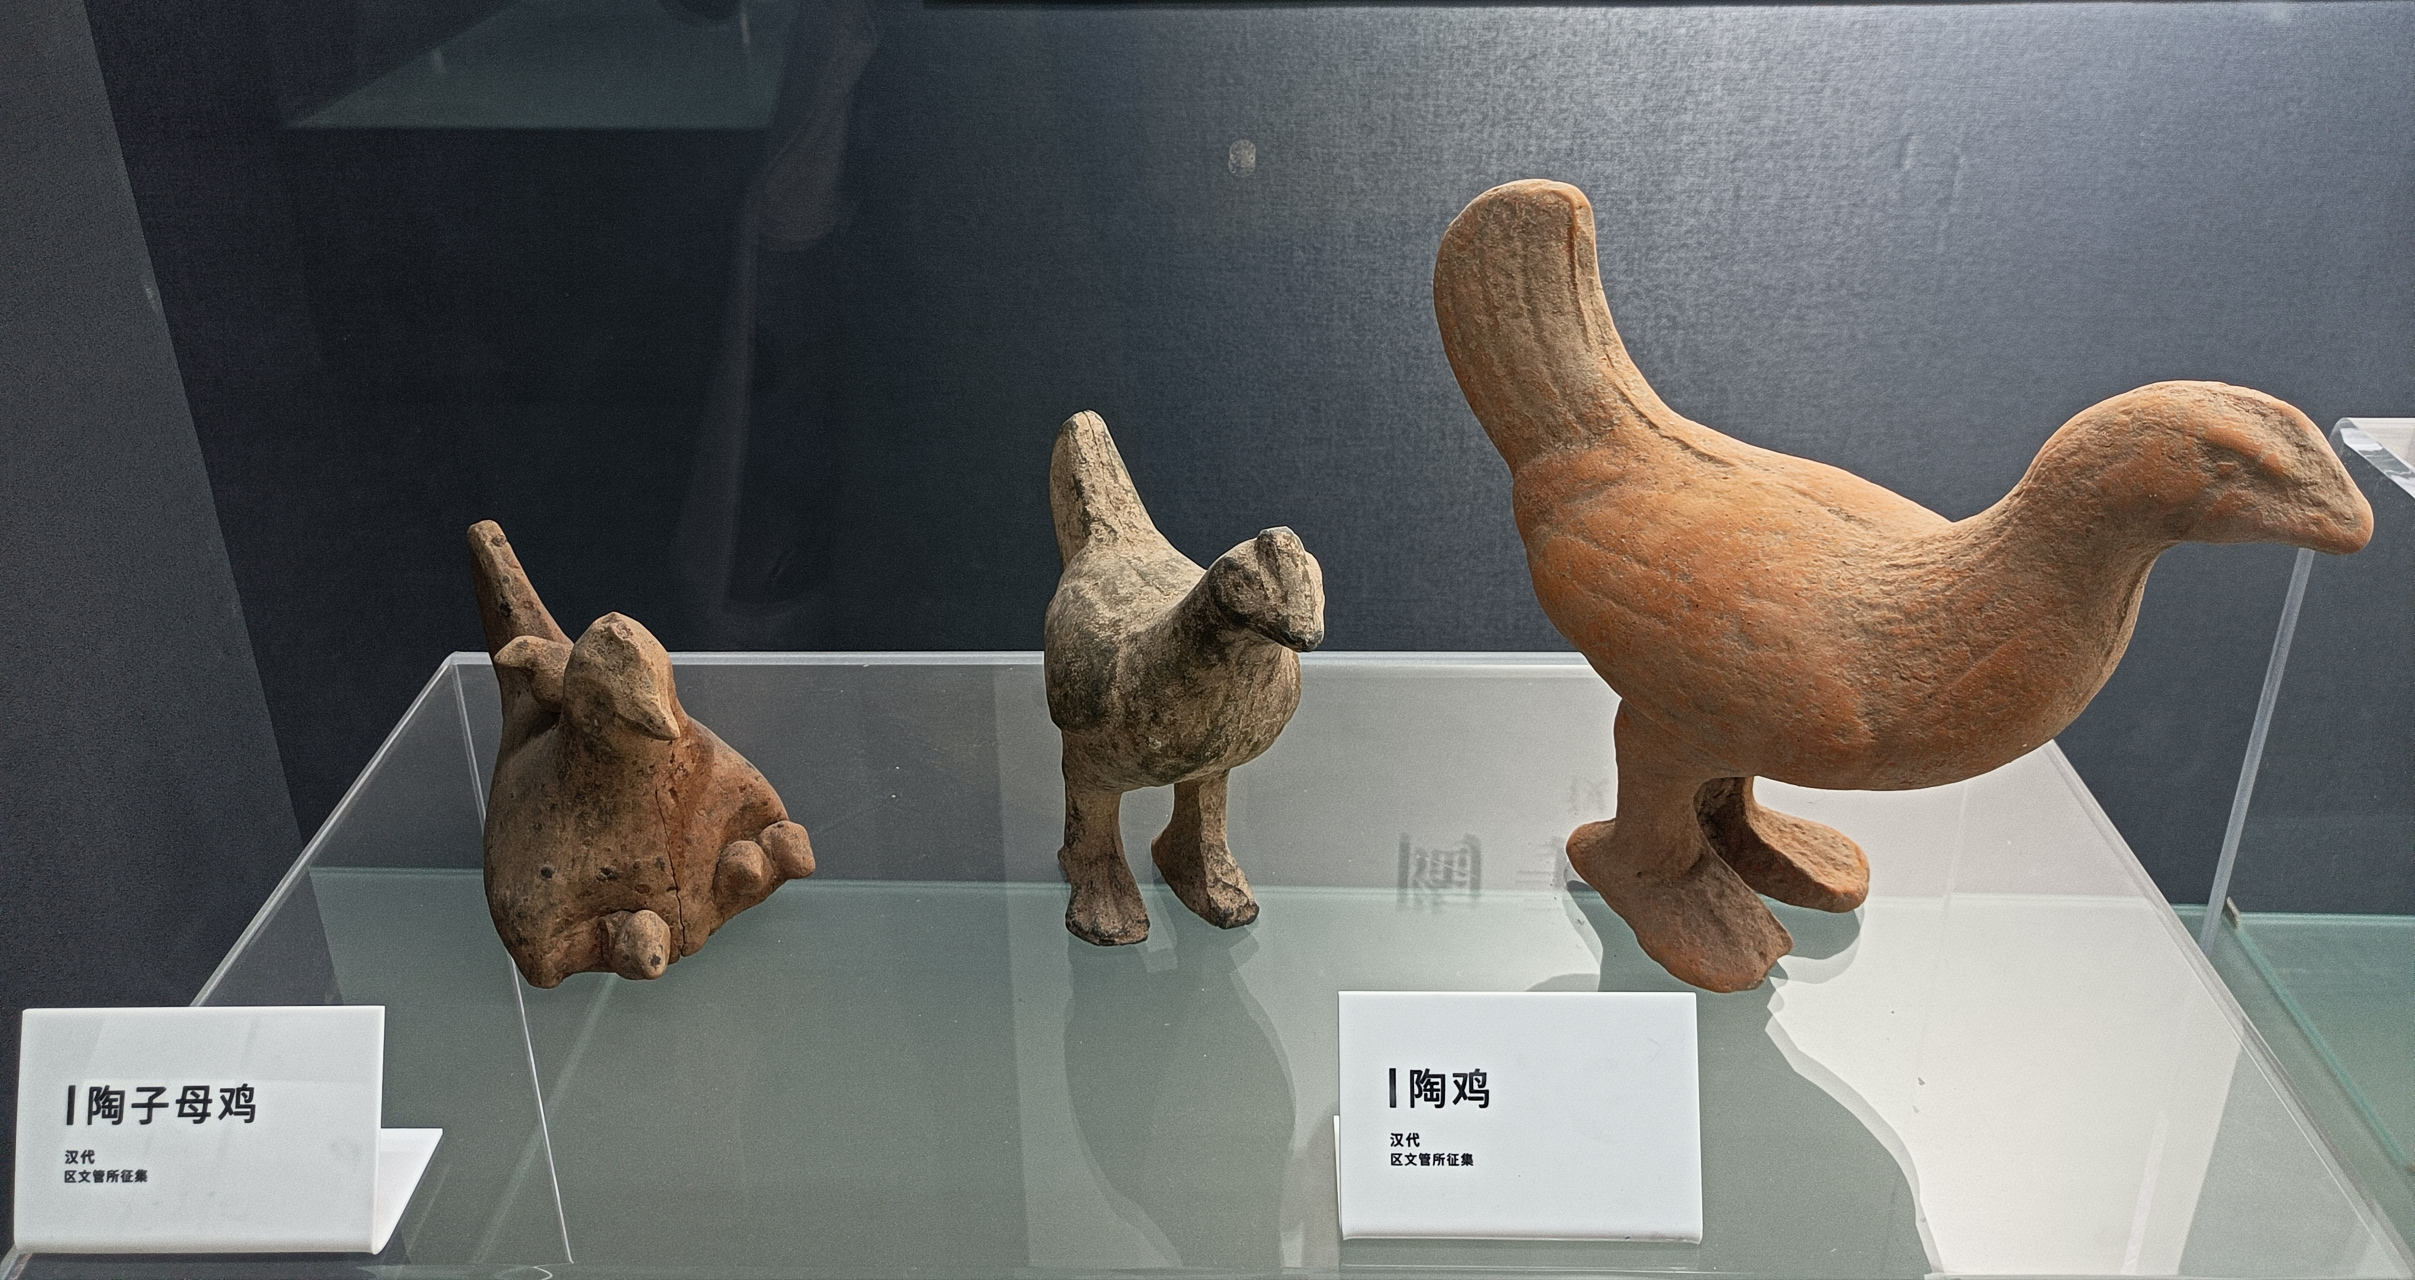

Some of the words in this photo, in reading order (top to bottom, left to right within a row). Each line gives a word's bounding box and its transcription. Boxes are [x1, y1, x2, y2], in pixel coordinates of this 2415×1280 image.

[1409, 1067, 1490, 1109] 陶鸡
[85, 1084, 257, 1126] 陶子母鸡
[1390, 1132, 1421, 1148] 汉代
[64, 1149, 95, 1165] 汉代
[1390, 1152, 1474, 1167] 区文管所征集
[64, 1169, 148, 1184] 区文管所征集
